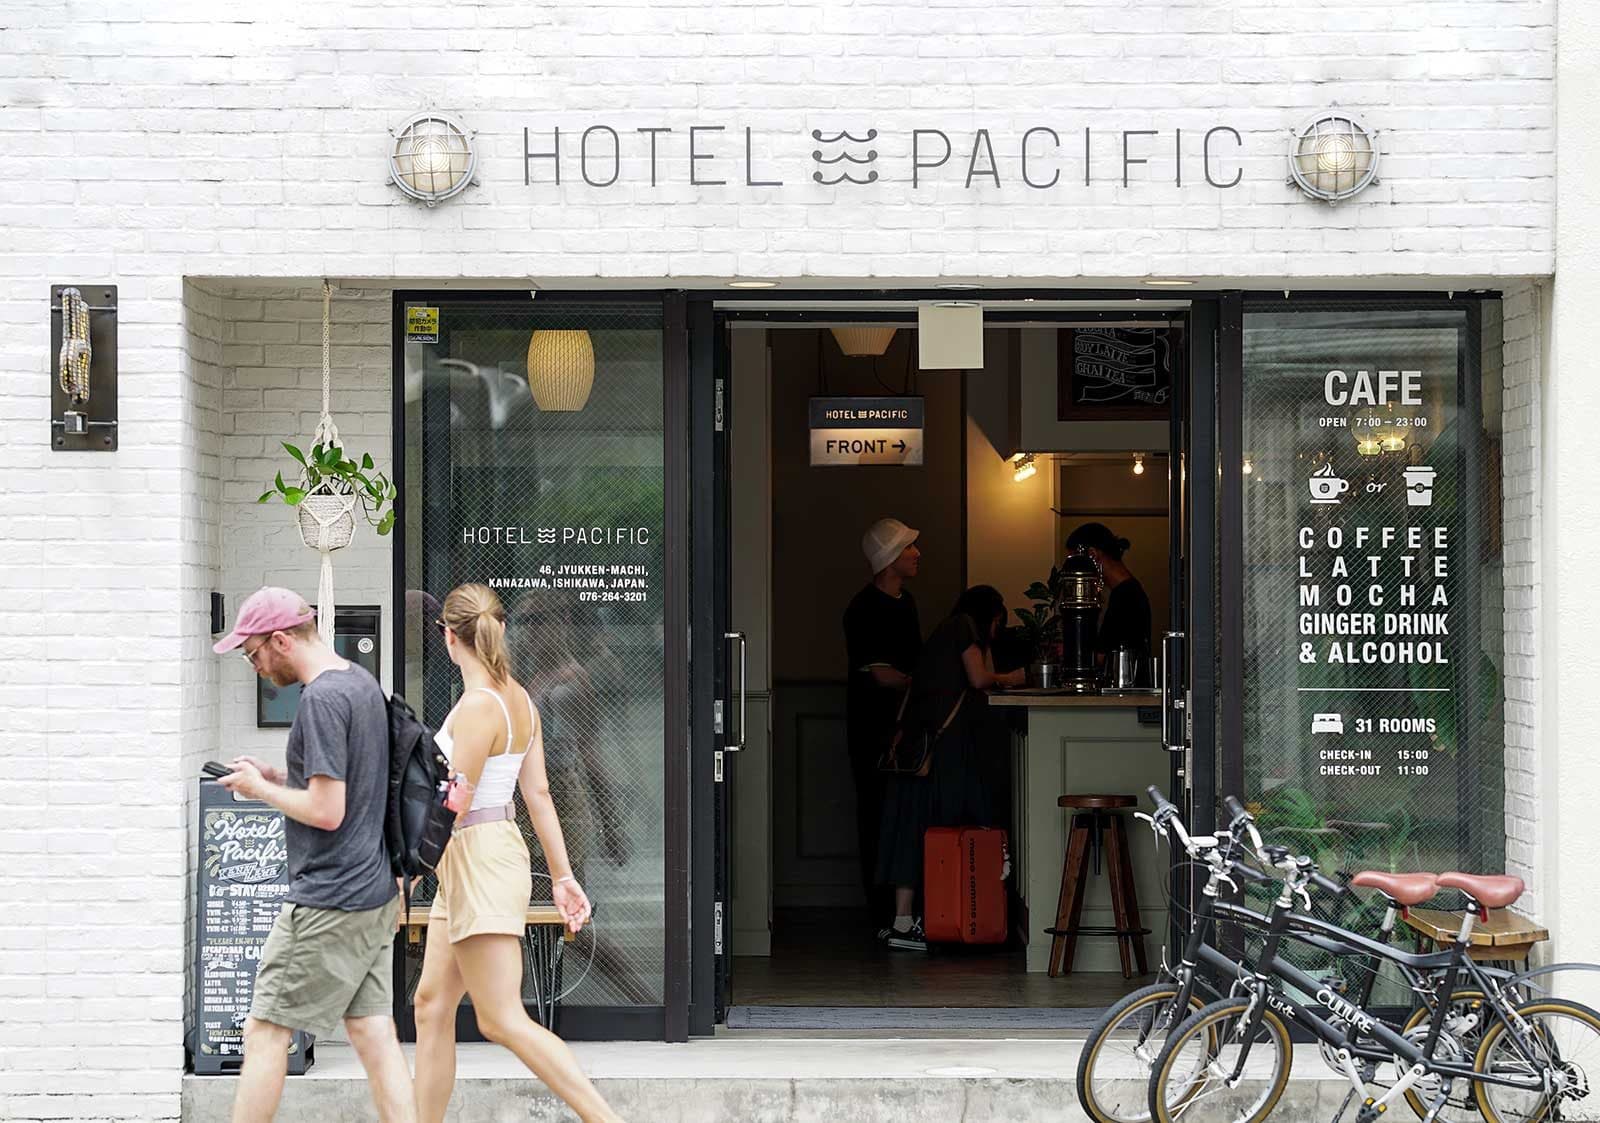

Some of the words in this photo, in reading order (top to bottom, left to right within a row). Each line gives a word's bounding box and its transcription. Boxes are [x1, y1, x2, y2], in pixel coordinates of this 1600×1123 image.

[523, 125, 784, 187] HOTEL
[911, 126, 1244, 189] PACIFIC
[1096, 344, 1130, 363] LATTE
[1077, 362, 1103, 376] CHAI
[1104, 367, 1126, 383] TEA
[1323, 369, 1423, 406] CAFE
[825, 410, 857, 420] HOTEL
[868, 410, 908, 420] PACIFIC
[1318, 417, 1348, 428] OPEN
[1356, 417, 1382, 428] 7:00
[1395, 417, 1428, 428] 23:00
[826, 439, 888, 454] FRONT
[1366, 482, 1388, 494] or
[463, 526, 532, 544] HOTEL
[562, 526, 650, 545] PACIFIC
[1299, 526, 1449, 549] COFFEE
[539, 565, 555, 577] 46,
[557, 565, 649, 577] JYUKKEN-MACHI,
[1299, 556, 1449, 578] LATTE
[488, 578, 551, 590] KANAZAWA,
[552, 578, 609, 590] ISHIKAWA,
[610, 578, 649, 589] JAPAN.
[579, 592, 647, 602] 076-264-3201
[1299, 584, 1449, 607] MOCHA
[1299, 612, 1377, 636] GINGER
[1384, 613, 1450, 636] DRINK
[1299, 641, 1317, 664] &
[1327, 641, 1449, 664] ALCOHOL
[1355, 718, 1374, 733] 31
[1379, 718, 1437, 733] ROOMS
[1319, 750, 1373, 760] CHECK-IN
[1397, 750, 1429, 760] 15:00
[1319, 765, 1382, 776] CHECK-OUT
[1397, 765, 1429, 776] 11:00
[213, 817, 285, 840] Hotel
[219, 839, 288, 867] Pacific
[229, 884, 258, 897] STAY
[1316, 989, 1376, 1034] CULTURE
